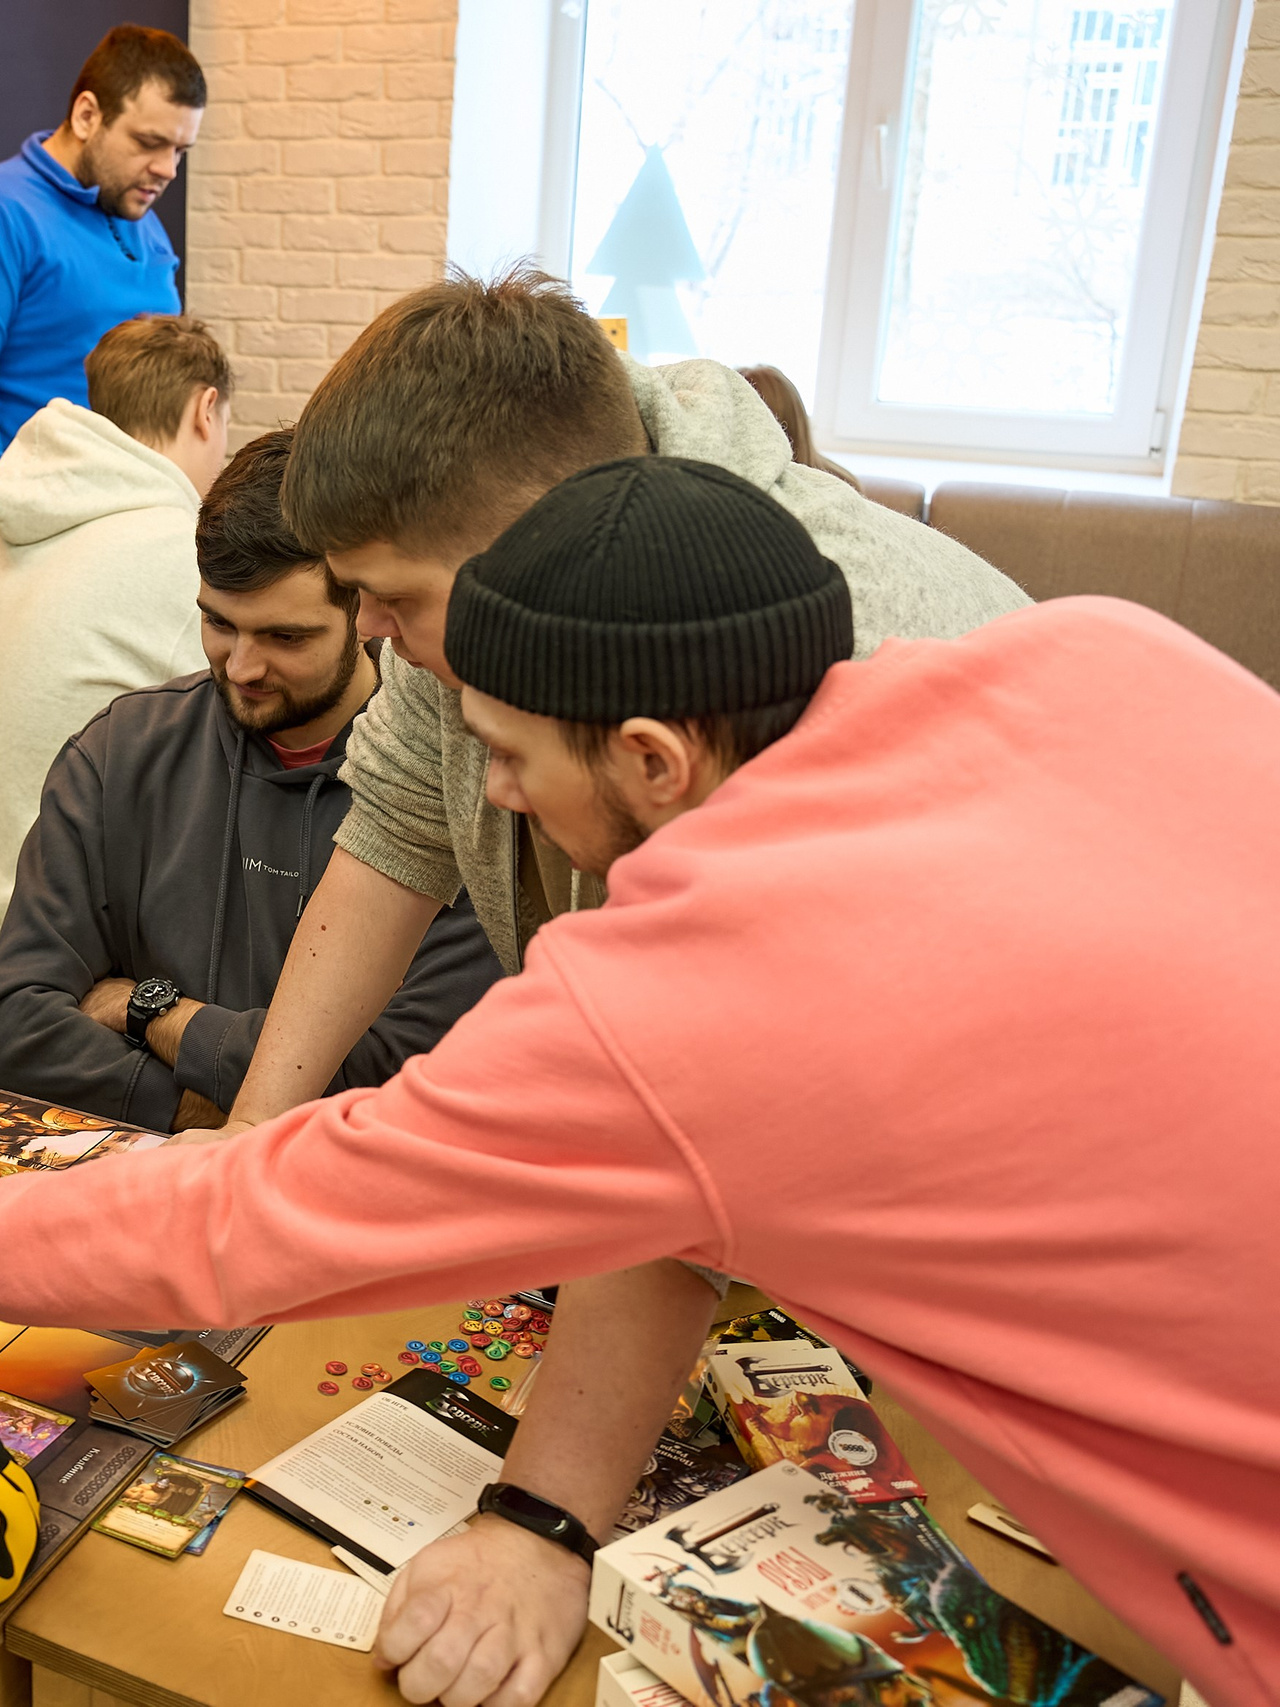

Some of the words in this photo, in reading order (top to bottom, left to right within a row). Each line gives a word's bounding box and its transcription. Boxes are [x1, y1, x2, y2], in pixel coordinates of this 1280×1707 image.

[263, 864, 279, 875] TOM
[391, 1400, 409, 1411] ИГРЕ
[332, 1428, 358, 1444] СОСТАВ
[357, 1439, 385, 1460] НАБОРА
[345, 1421, 375, 1438] УСЛОВИЕ
[374, 1435, 404, 1457] ПОБЕДЫ
[58, 1447, 101, 1484] Кладбище
[819, 1469, 868, 1481] Дружина
